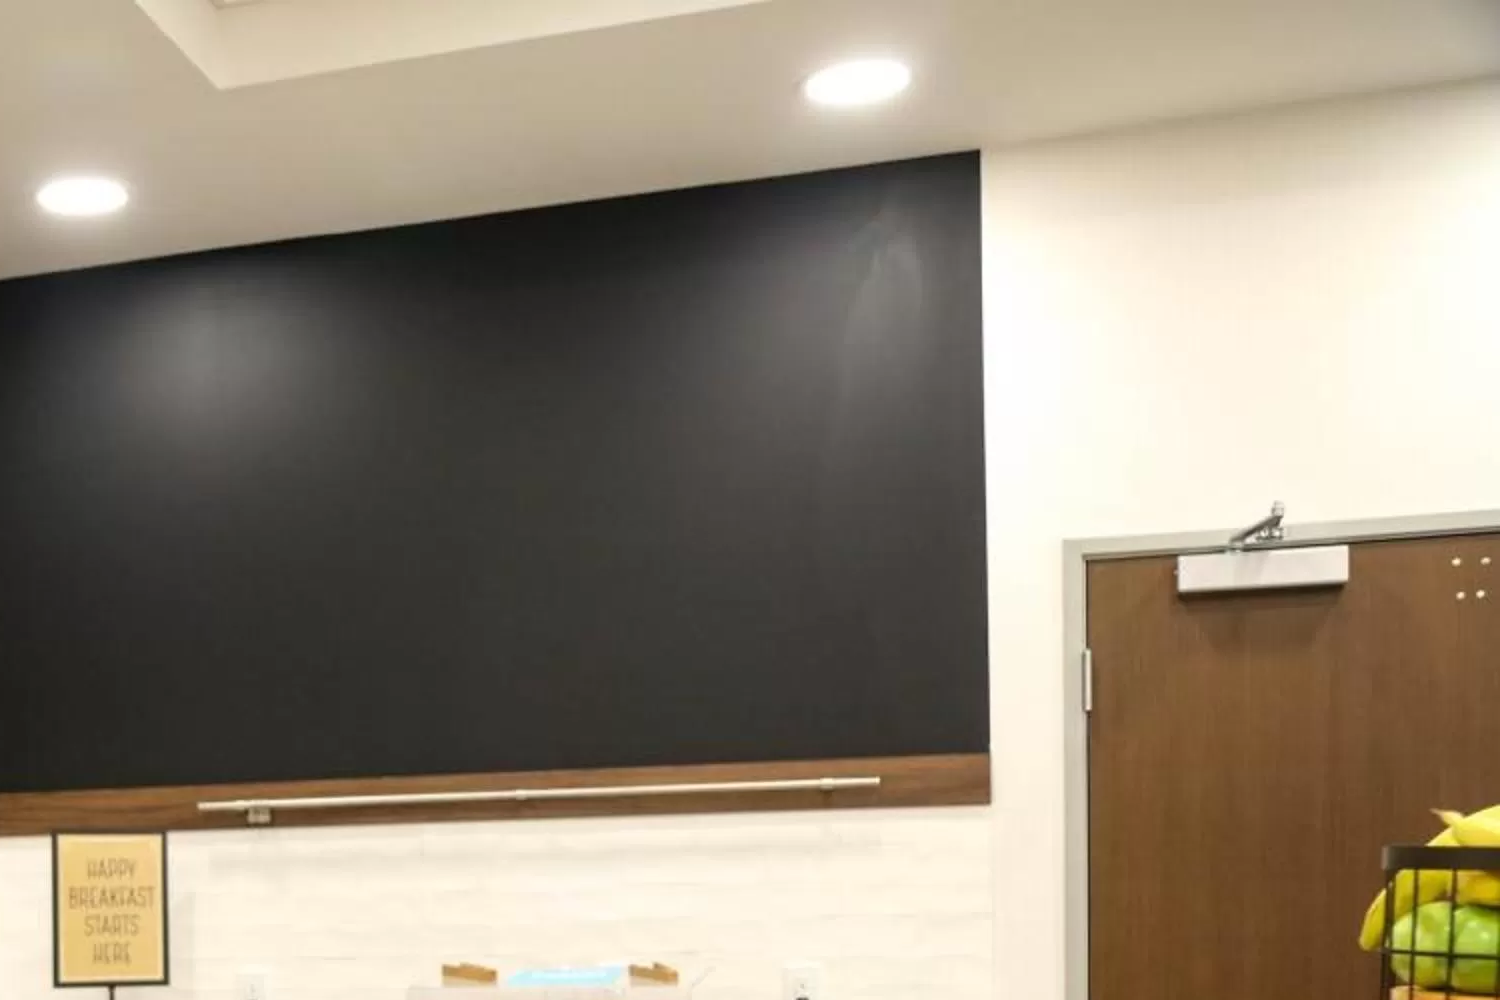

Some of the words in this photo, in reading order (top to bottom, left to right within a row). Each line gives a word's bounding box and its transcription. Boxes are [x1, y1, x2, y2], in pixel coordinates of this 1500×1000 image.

[87, 857, 137, 879] HAPPY
[68, 885, 156, 910] BREAKFAST
[84, 913, 140, 937] STARTS
[92, 941, 132, 967] HERE
